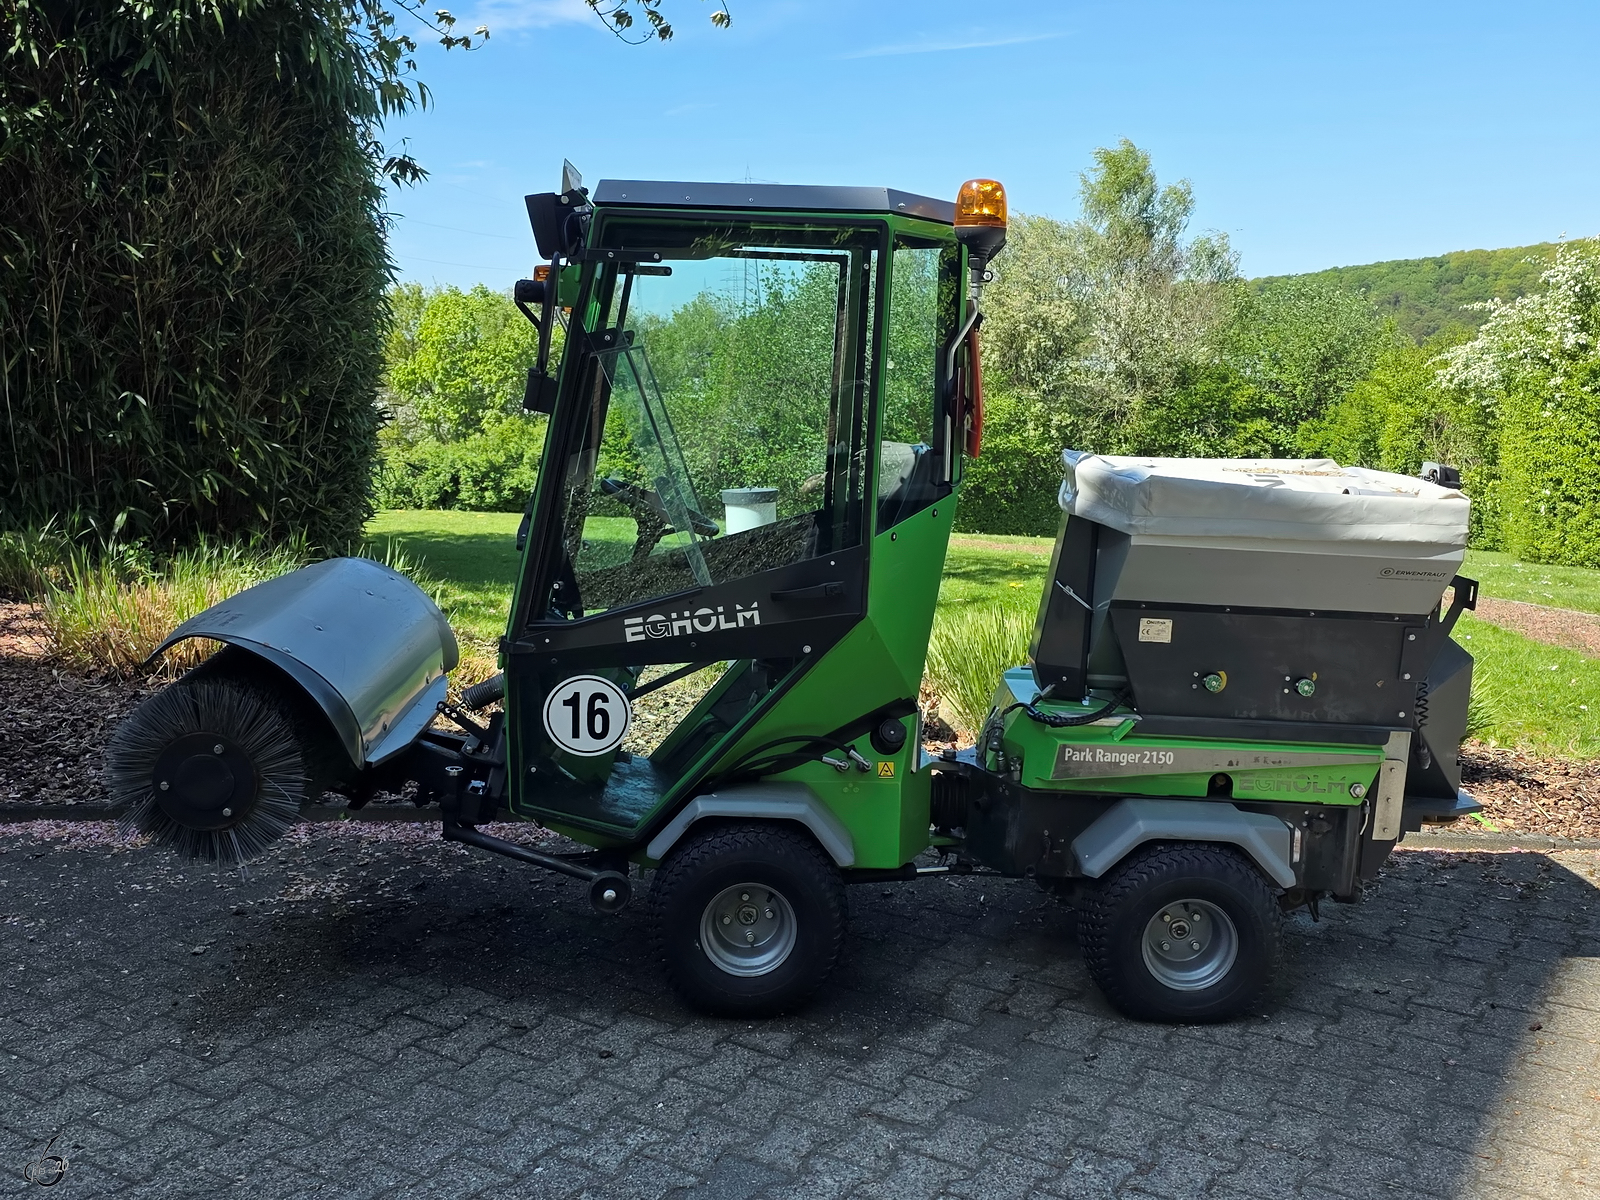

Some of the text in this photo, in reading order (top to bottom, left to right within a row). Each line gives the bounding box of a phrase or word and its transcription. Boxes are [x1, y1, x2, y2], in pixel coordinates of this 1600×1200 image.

[1395, 570, 1447, 578] ERWENTRAUT
[624, 601, 760, 642] EGHOLM
[562, 691, 610, 740] 16
[1064, 747, 1174, 766] Park Ranger 2150
[1238, 772, 1347, 794] EGHOLM
